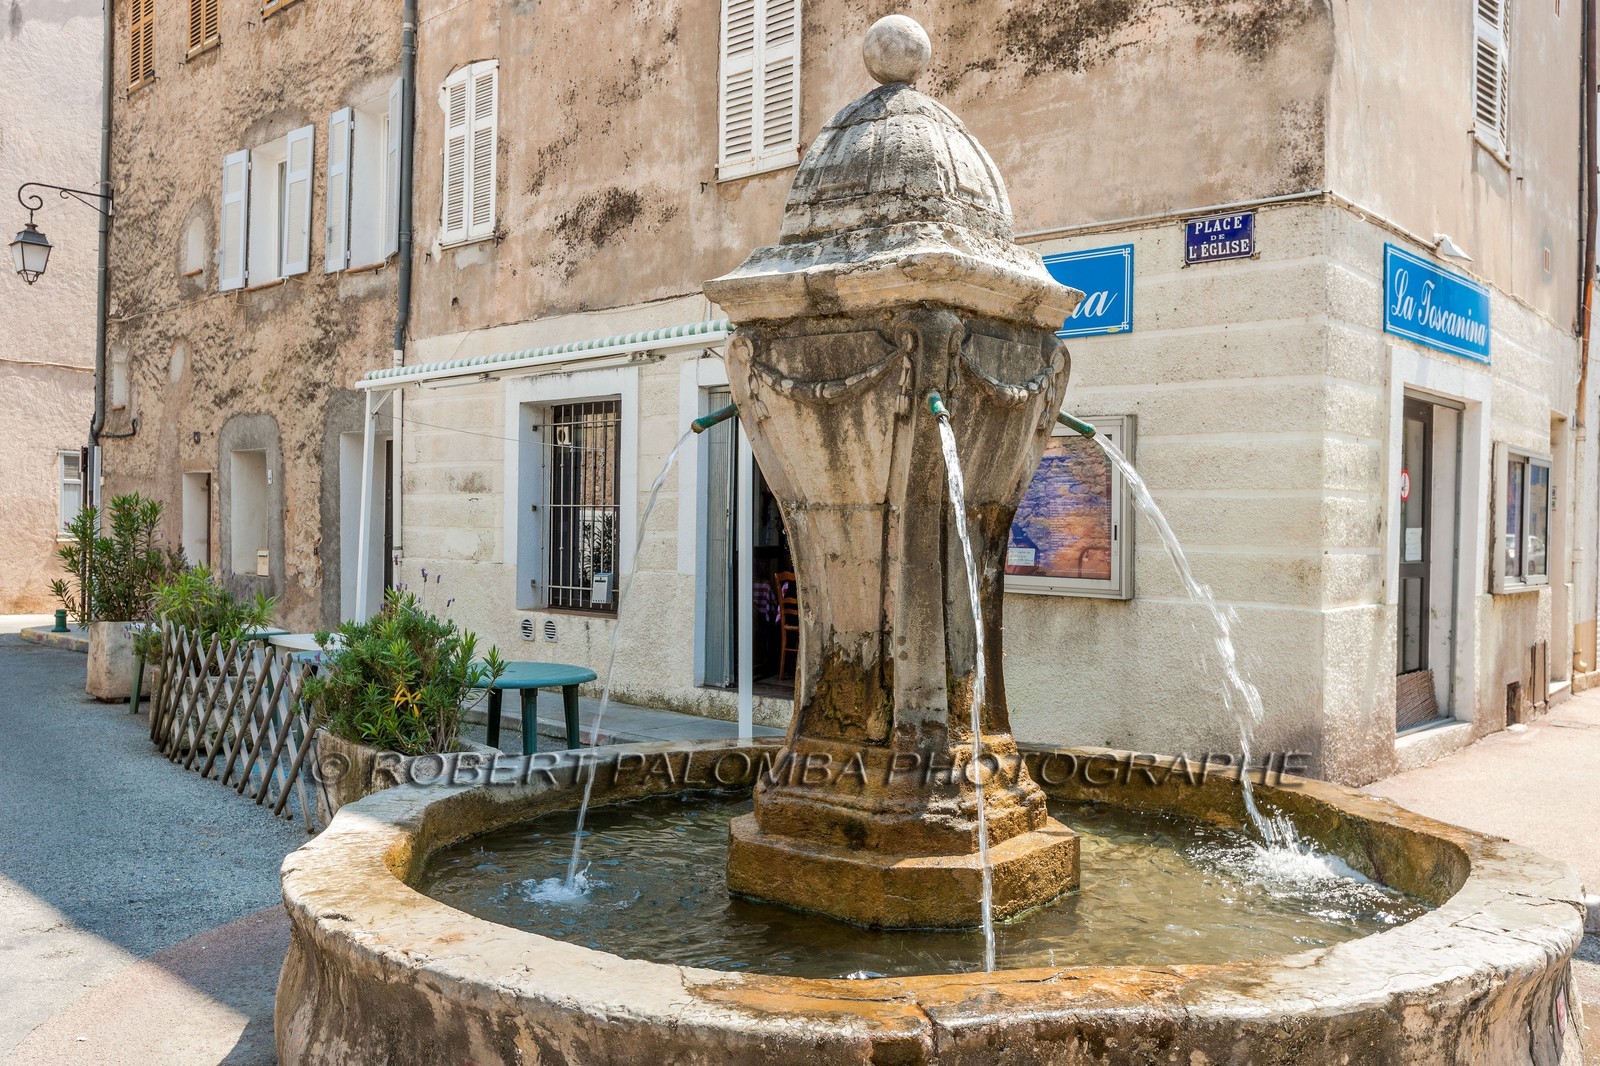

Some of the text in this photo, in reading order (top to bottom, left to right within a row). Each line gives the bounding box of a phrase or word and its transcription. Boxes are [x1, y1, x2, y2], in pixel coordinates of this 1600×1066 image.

[1195, 216, 1242, 235] PLACE
[1210, 233, 1225, 241] DE
[1391, 268, 1488, 346] La Toscanina
